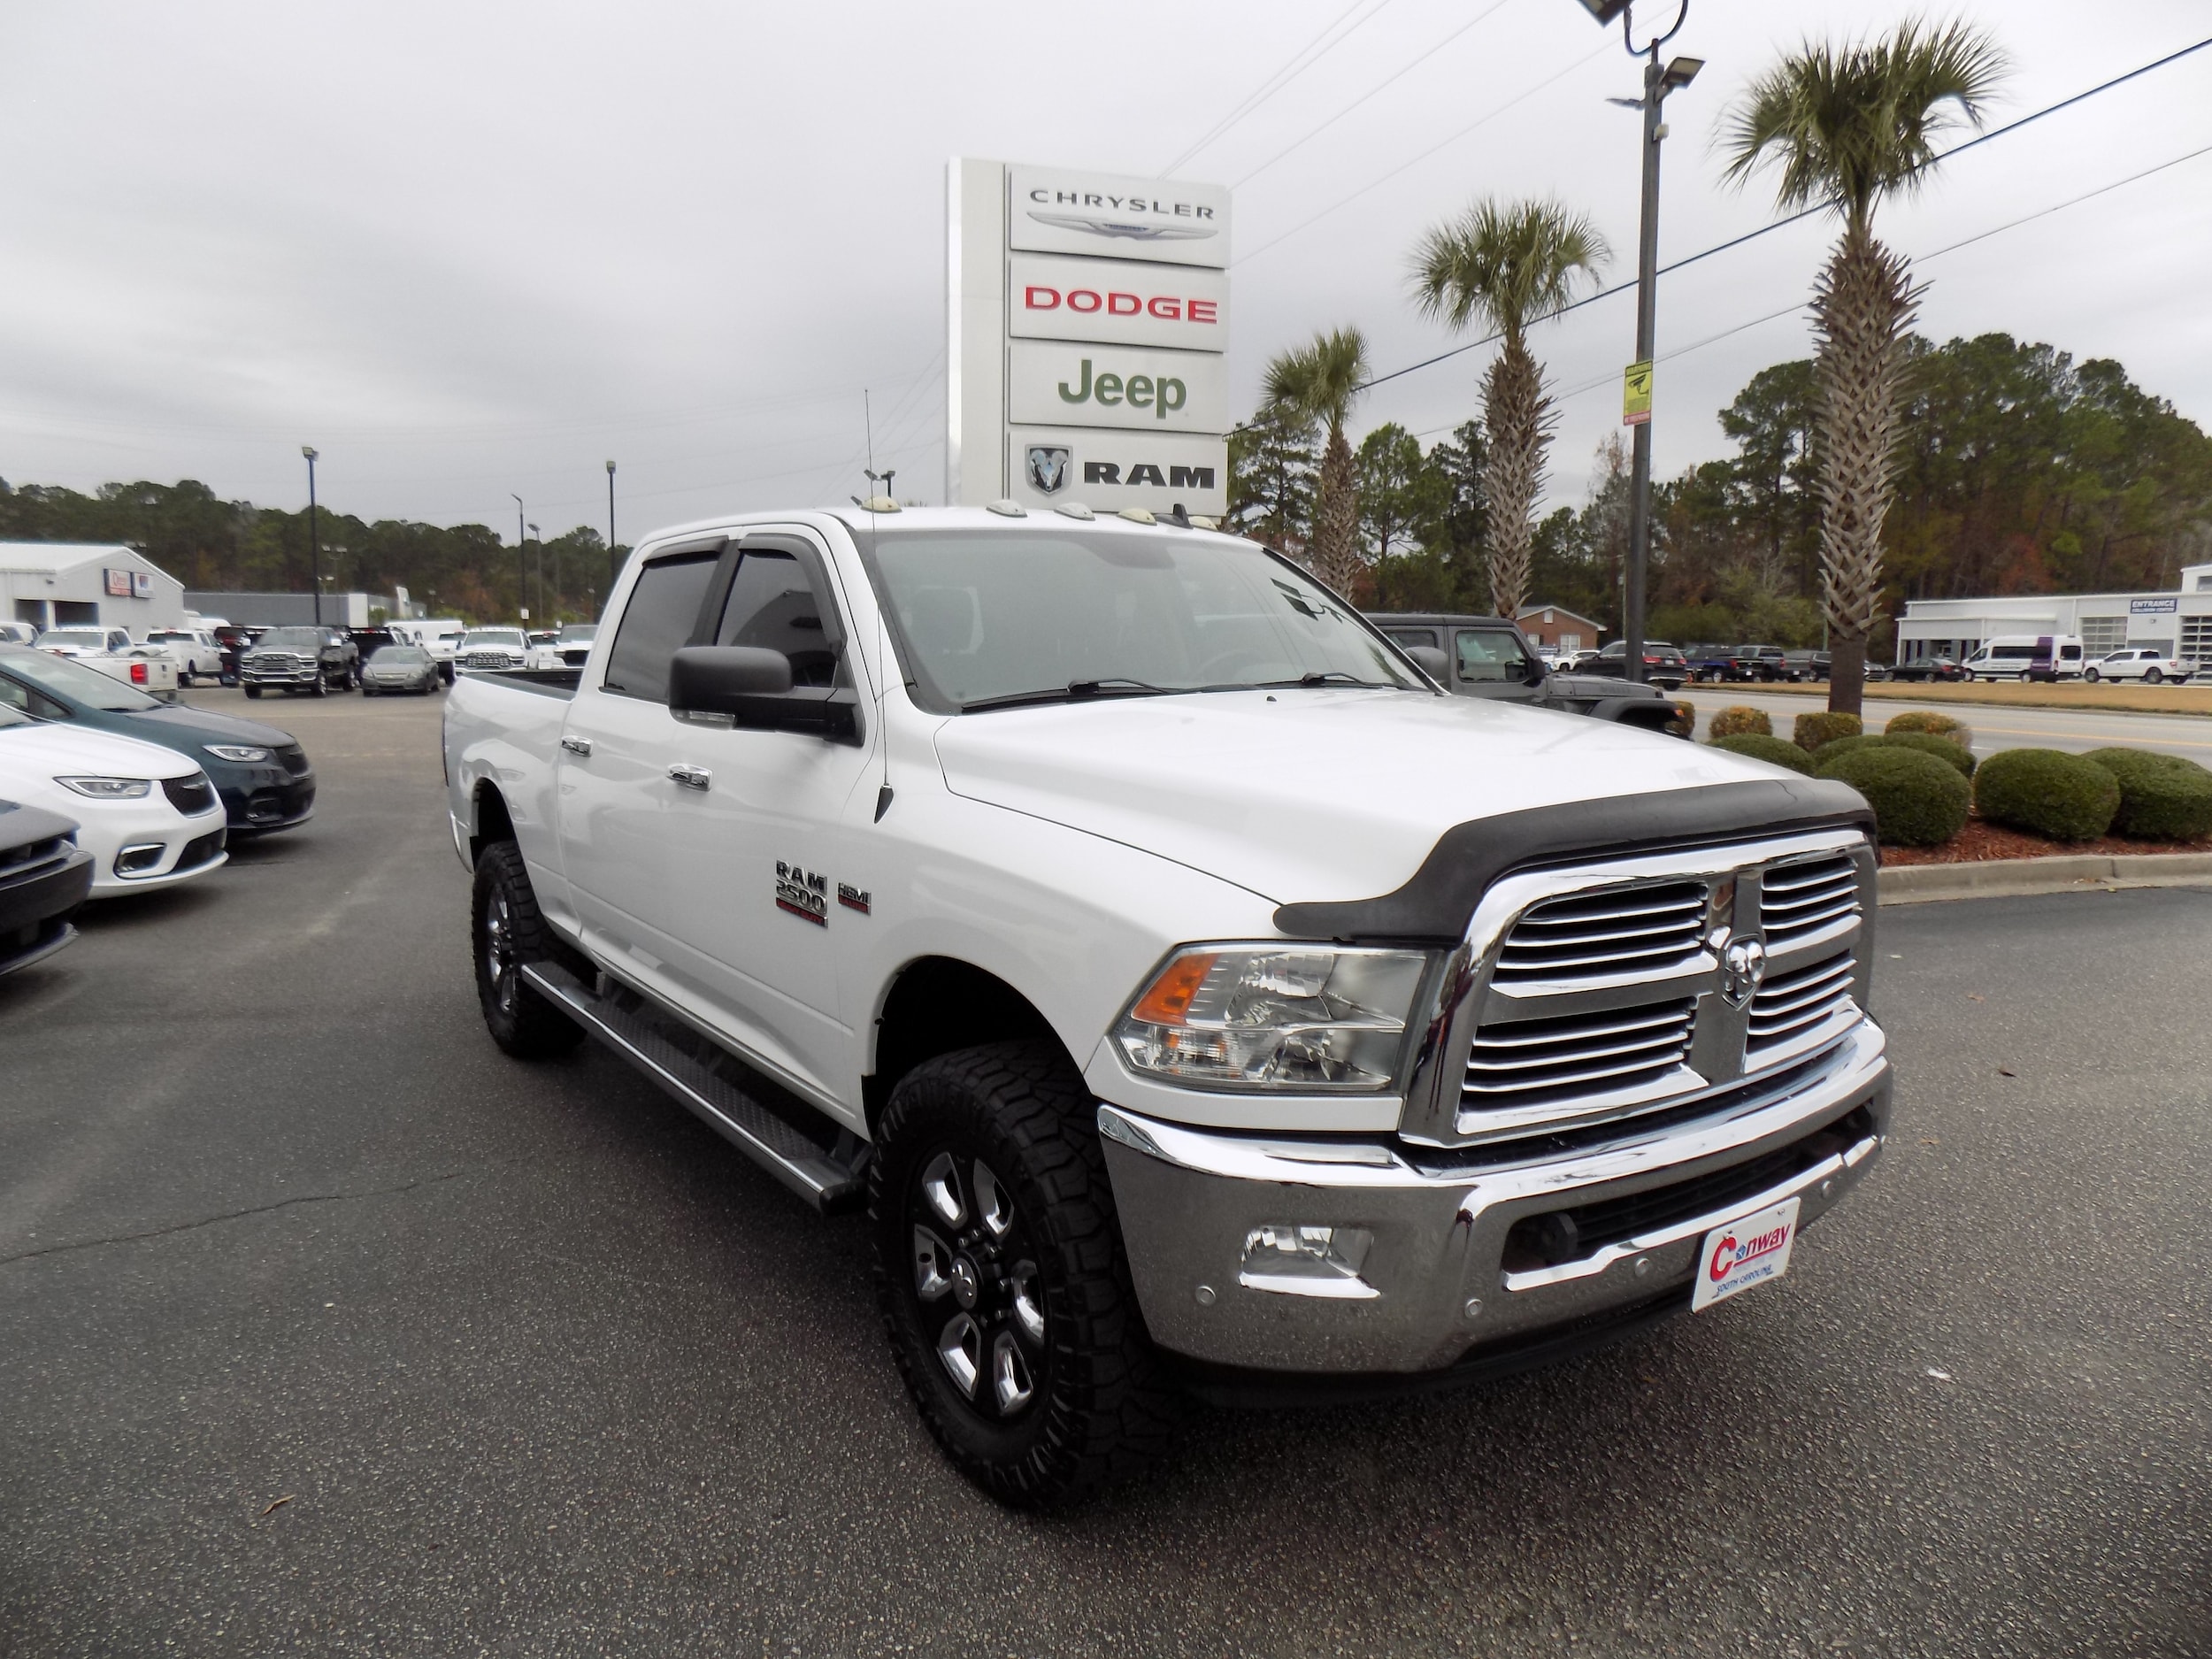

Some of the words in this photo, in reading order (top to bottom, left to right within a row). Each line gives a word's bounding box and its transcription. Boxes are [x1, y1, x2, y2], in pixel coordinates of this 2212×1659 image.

[1030, 188, 1214, 220] CHRYSLER
[1025, 286, 1217, 325] DODGE
[1057, 358, 1187, 419] Jeep
[1083, 461, 1215, 490] RAM
[776, 858, 828, 895] RAM
[838, 882, 871, 905] HEMI
[1709, 1223, 1791, 1282] Conway
